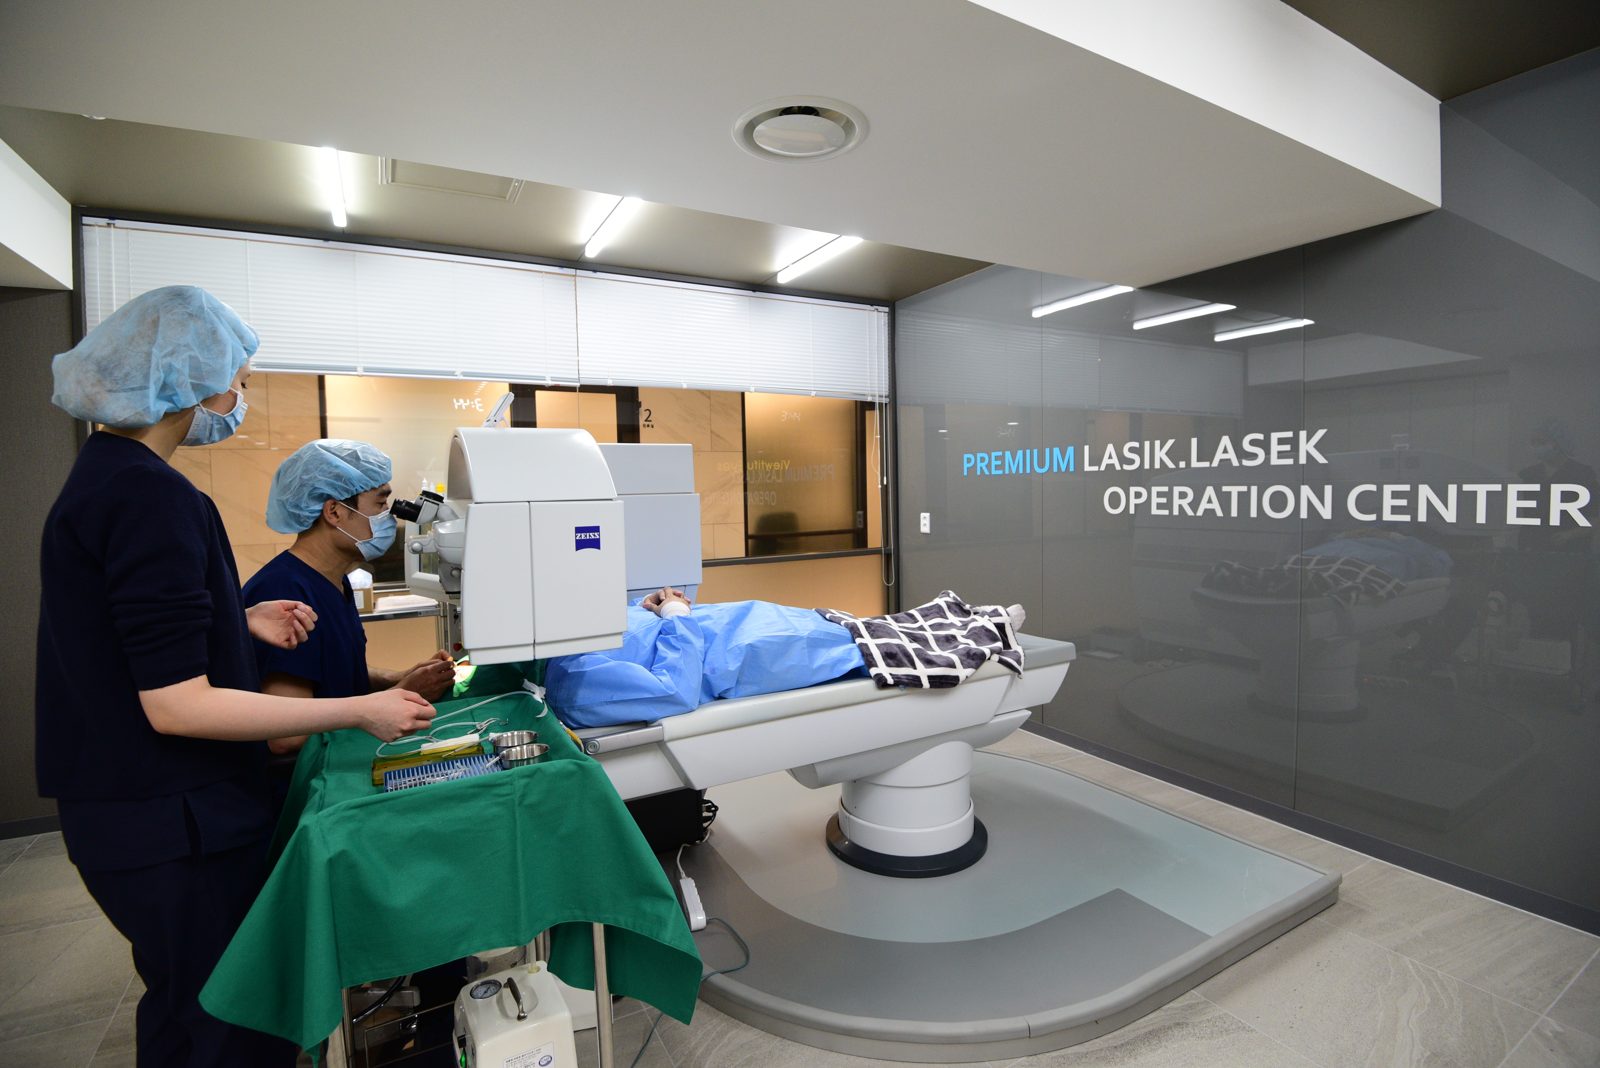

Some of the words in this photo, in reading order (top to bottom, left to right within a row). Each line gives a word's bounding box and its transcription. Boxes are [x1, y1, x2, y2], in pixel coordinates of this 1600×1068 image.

[643, 408, 653, 422] 2
[962, 445, 1076, 477] PREMIUM
[1083, 428, 1329, 472] LASIK.LASEK
[1103, 484, 1333, 520] OPERATION
[1346, 483, 1592, 527] CENTER
[575, 531, 600, 540] ZEISS
